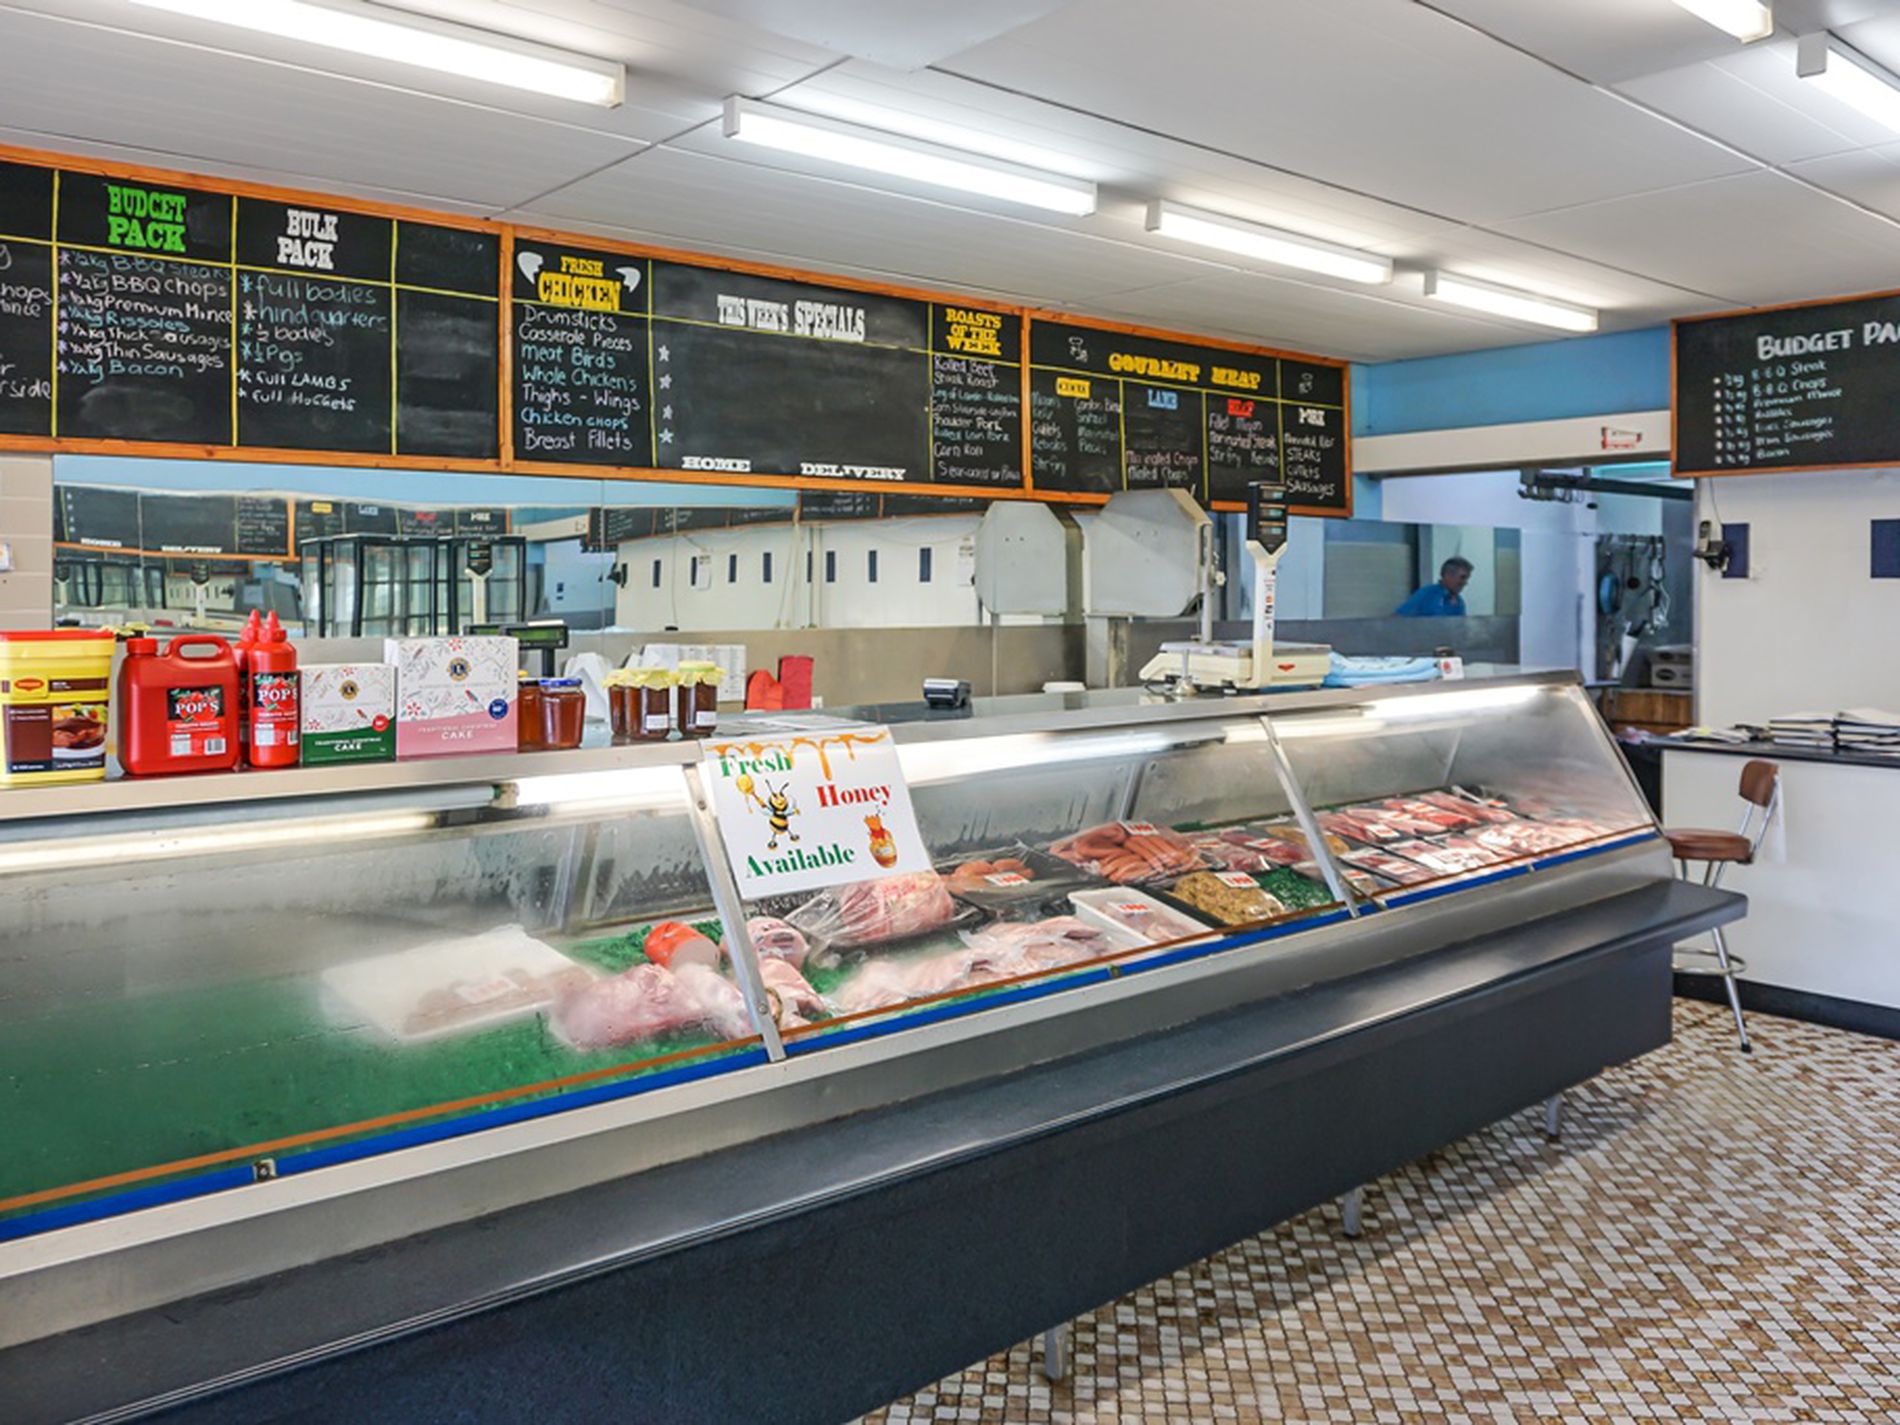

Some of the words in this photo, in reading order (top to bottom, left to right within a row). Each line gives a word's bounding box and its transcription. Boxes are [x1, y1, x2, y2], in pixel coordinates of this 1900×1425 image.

[106, 185, 187, 223] BUDGET
[107, 216, 187, 252] PACK
[286, 208, 338, 242] BULK
[277, 236, 334, 269] PACK
[560, 255, 604, 278] FRESH
[305, 281, 377, 304] bodies
[538, 271, 621, 312] CHICKEN
[523, 303, 617, 332] Drumsticks
[794, 300, 866, 342] SPECIALS
[945, 307, 1003, 329] ROASTS
[273, 325, 334, 347] bodies
[518, 322, 586, 346] Casserole
[950, 323, 968, 338] OF
[969, 326, 997, 342] THE
[1757, 329, 1854, 361] BUDGET
[1863, 321, 1900, 346] PA
[570, 345, 616, 369] Birds
[945, 334, 1002, 356] WEEK
[109, 359, 184, 379] Bacon
[522, 363, 566, 386] Whole
[1108, 352, 1201, 383] GOURMET
[1210, 366, 1262, 390] MEAT
[522, 382, 572, 412] Thighs
[593, 388, 641, 416] Wings
[520, 406, 582, 427] Chicken
[975, 416, 1003, 432] Pork
[523, 426, 576, 450] Breast
[681, 456, 751, 473] HOME
[800, 462, 907, 481] DELIVERY
[174, 701, 220, 715] POP'S
[334, 742, 362, 753] CAKE
[441, 731, 474, 741] CAKE
[718, 751, 792, 778] Fresh
[816, 784, 892, 808] Honey
[746, 843, 855, 879] Available
